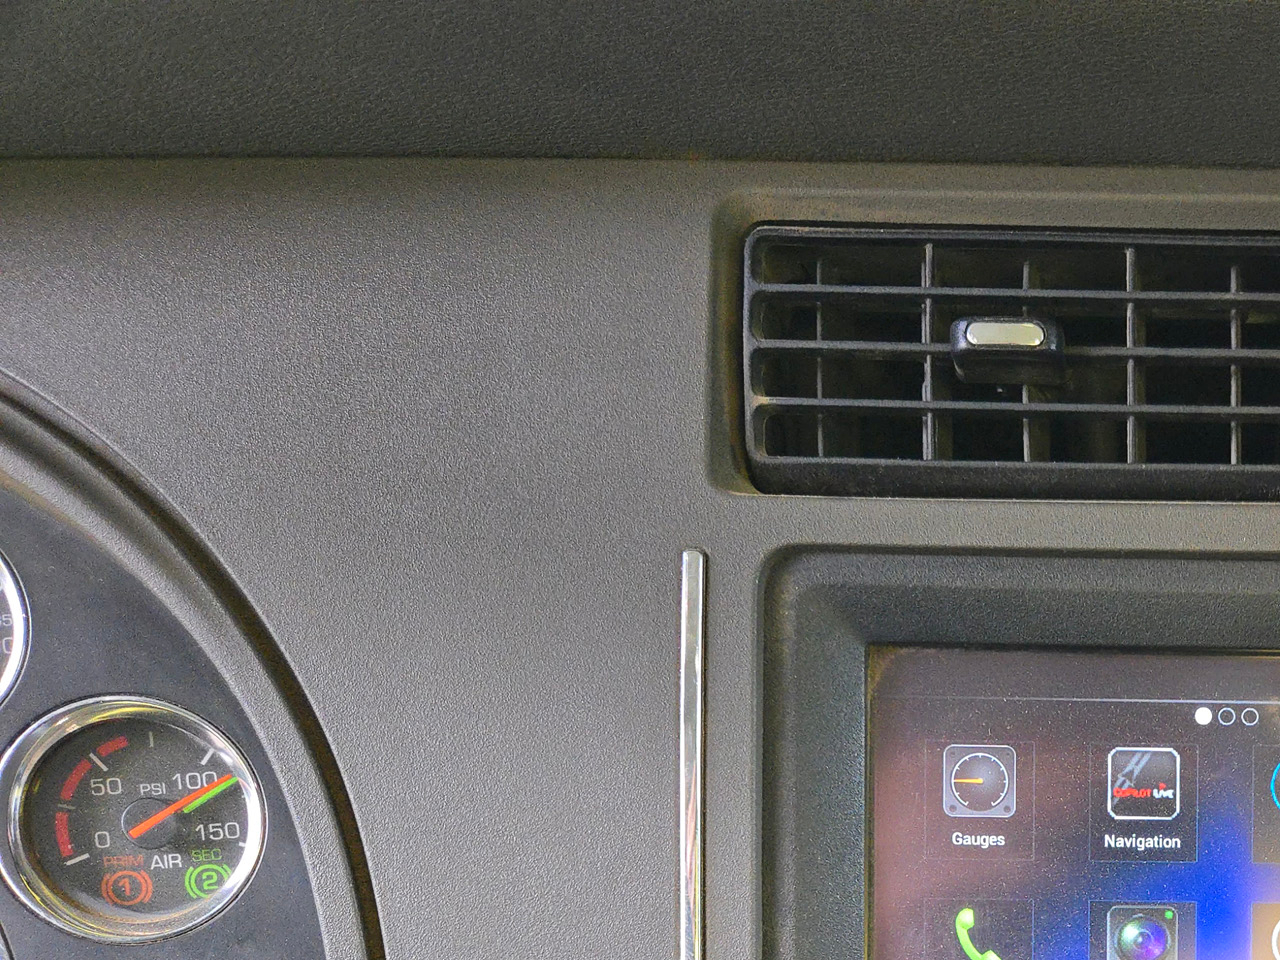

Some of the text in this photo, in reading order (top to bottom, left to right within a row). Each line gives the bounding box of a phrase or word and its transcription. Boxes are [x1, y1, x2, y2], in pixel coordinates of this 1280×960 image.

[90, 771, 218, 796] 50 PSI 100
[94, 831, 110, 849] 0
[195, 822, 240, 841] 150
[952, 832, 1006, 851] Gauges
[1104, 835, 1181, 851] Navigation
[103, 849, 222, 870] PRIM AIR SEC
